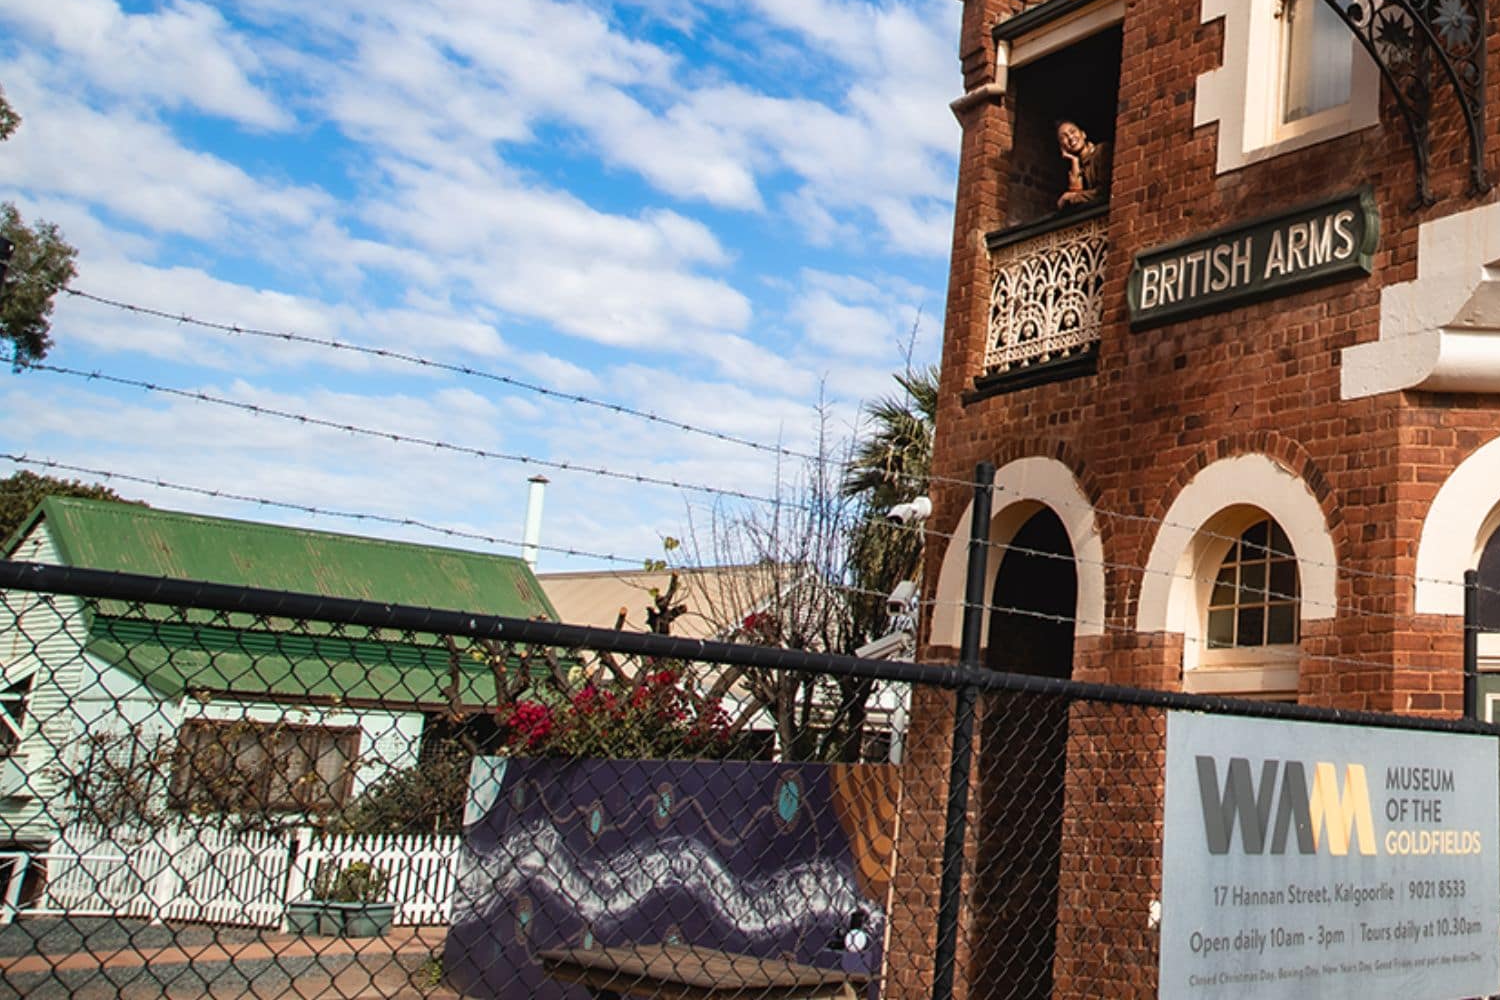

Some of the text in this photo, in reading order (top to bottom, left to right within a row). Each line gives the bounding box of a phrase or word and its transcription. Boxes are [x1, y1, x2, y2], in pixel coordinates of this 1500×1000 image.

[1140, 209, 1355, 310] BRITISH ARMS
[1385, 767, 1455, 792] MUSEUM
[1195, 755, 1378, 856] WAM
[1385, 799, 1442, 823] OF THE
[1385, 830, 1481, 855] GOLDFIELDS
[1214, 879, 1466, 907] 17 Hannan Street, Kalgoorlie 9021 8533
[1189, 931, 1231, 958] Open
[1233, 928, 1266, 955] daily
[1270, 927, 1305, 948] 10am
[1317, 924, 1345, 950] 3pm
[1360, 921, 1391, 942] Tours
[1394, 920, 1420, 944] daily
[1423, 920, 1434, 938] at
[1437, 917, 1482, 937] 10.30am
